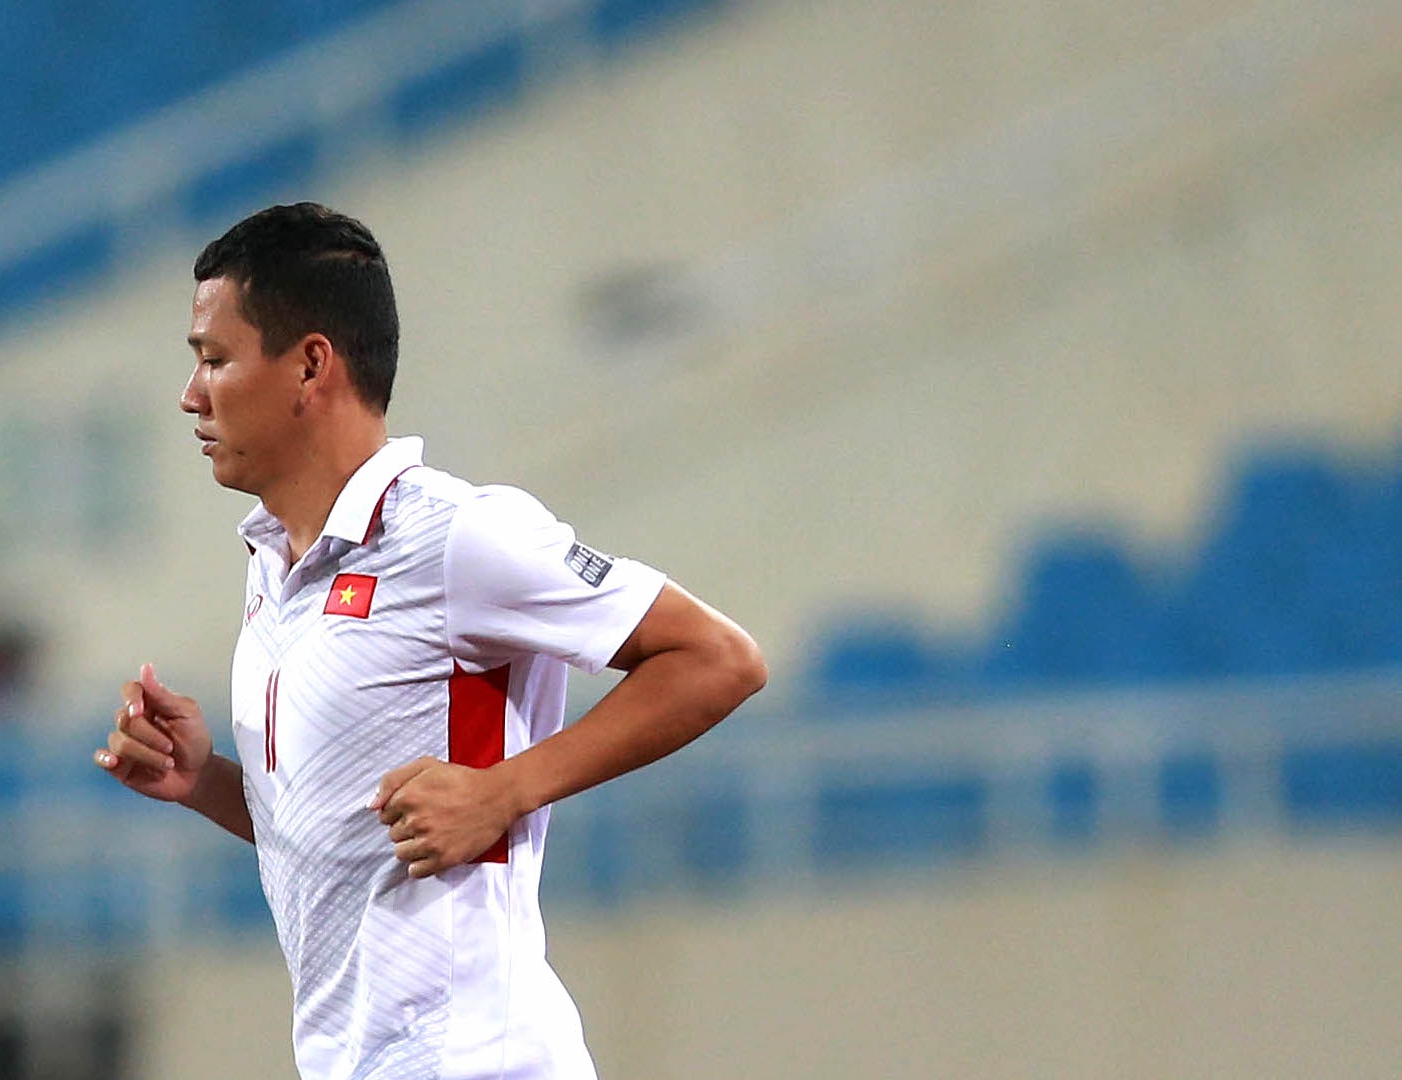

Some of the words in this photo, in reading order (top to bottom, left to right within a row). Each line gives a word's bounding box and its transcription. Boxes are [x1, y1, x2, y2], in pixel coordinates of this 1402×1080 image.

[570, 546, 592, 574] ONE
[582, 556, 606, 583] ONE
[265, 667, 281, 773] 11
